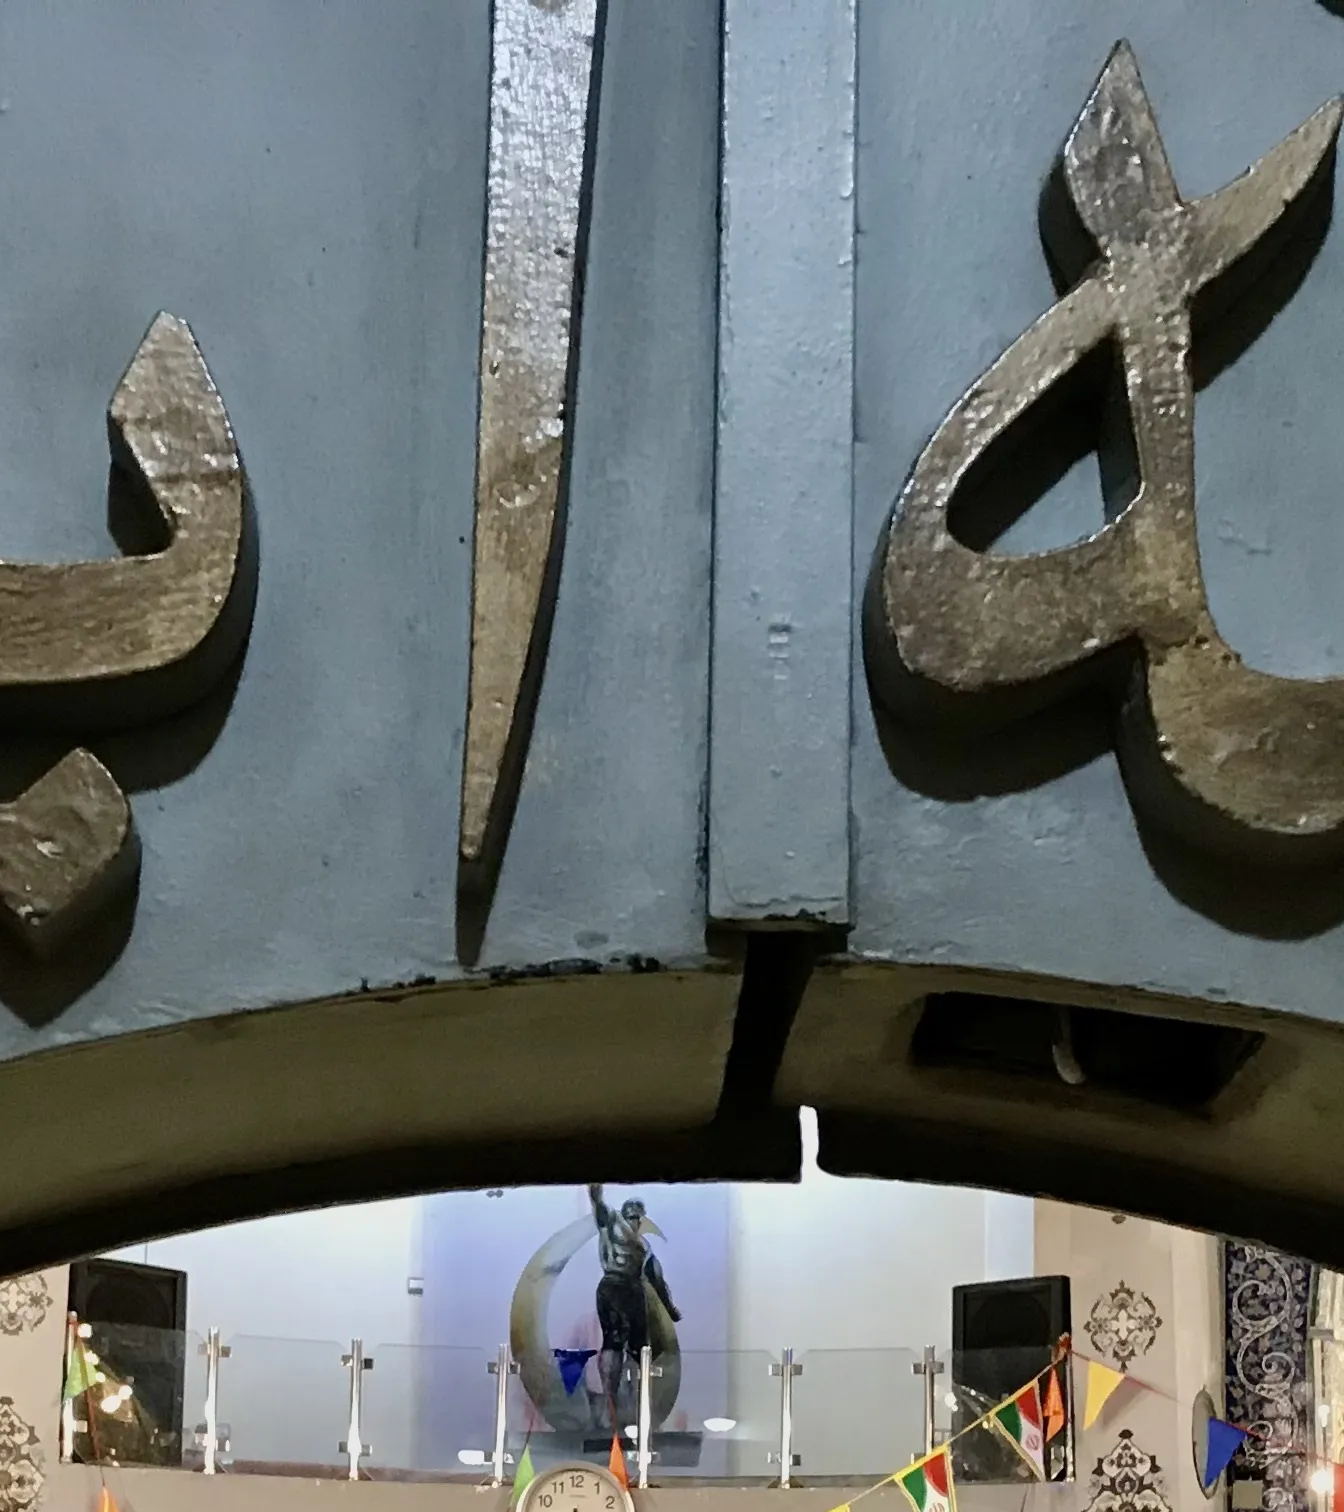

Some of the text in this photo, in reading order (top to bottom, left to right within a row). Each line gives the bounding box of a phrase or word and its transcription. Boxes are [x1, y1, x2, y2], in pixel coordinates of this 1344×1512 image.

[552, 1481, 565, 1494] 11
[569, 1474, 585, 1488] 12
[594, 1481, 600, 1494] 1
[538, 1494, 553, 1508] 10
[605, 1495, 616, 1509] 2
